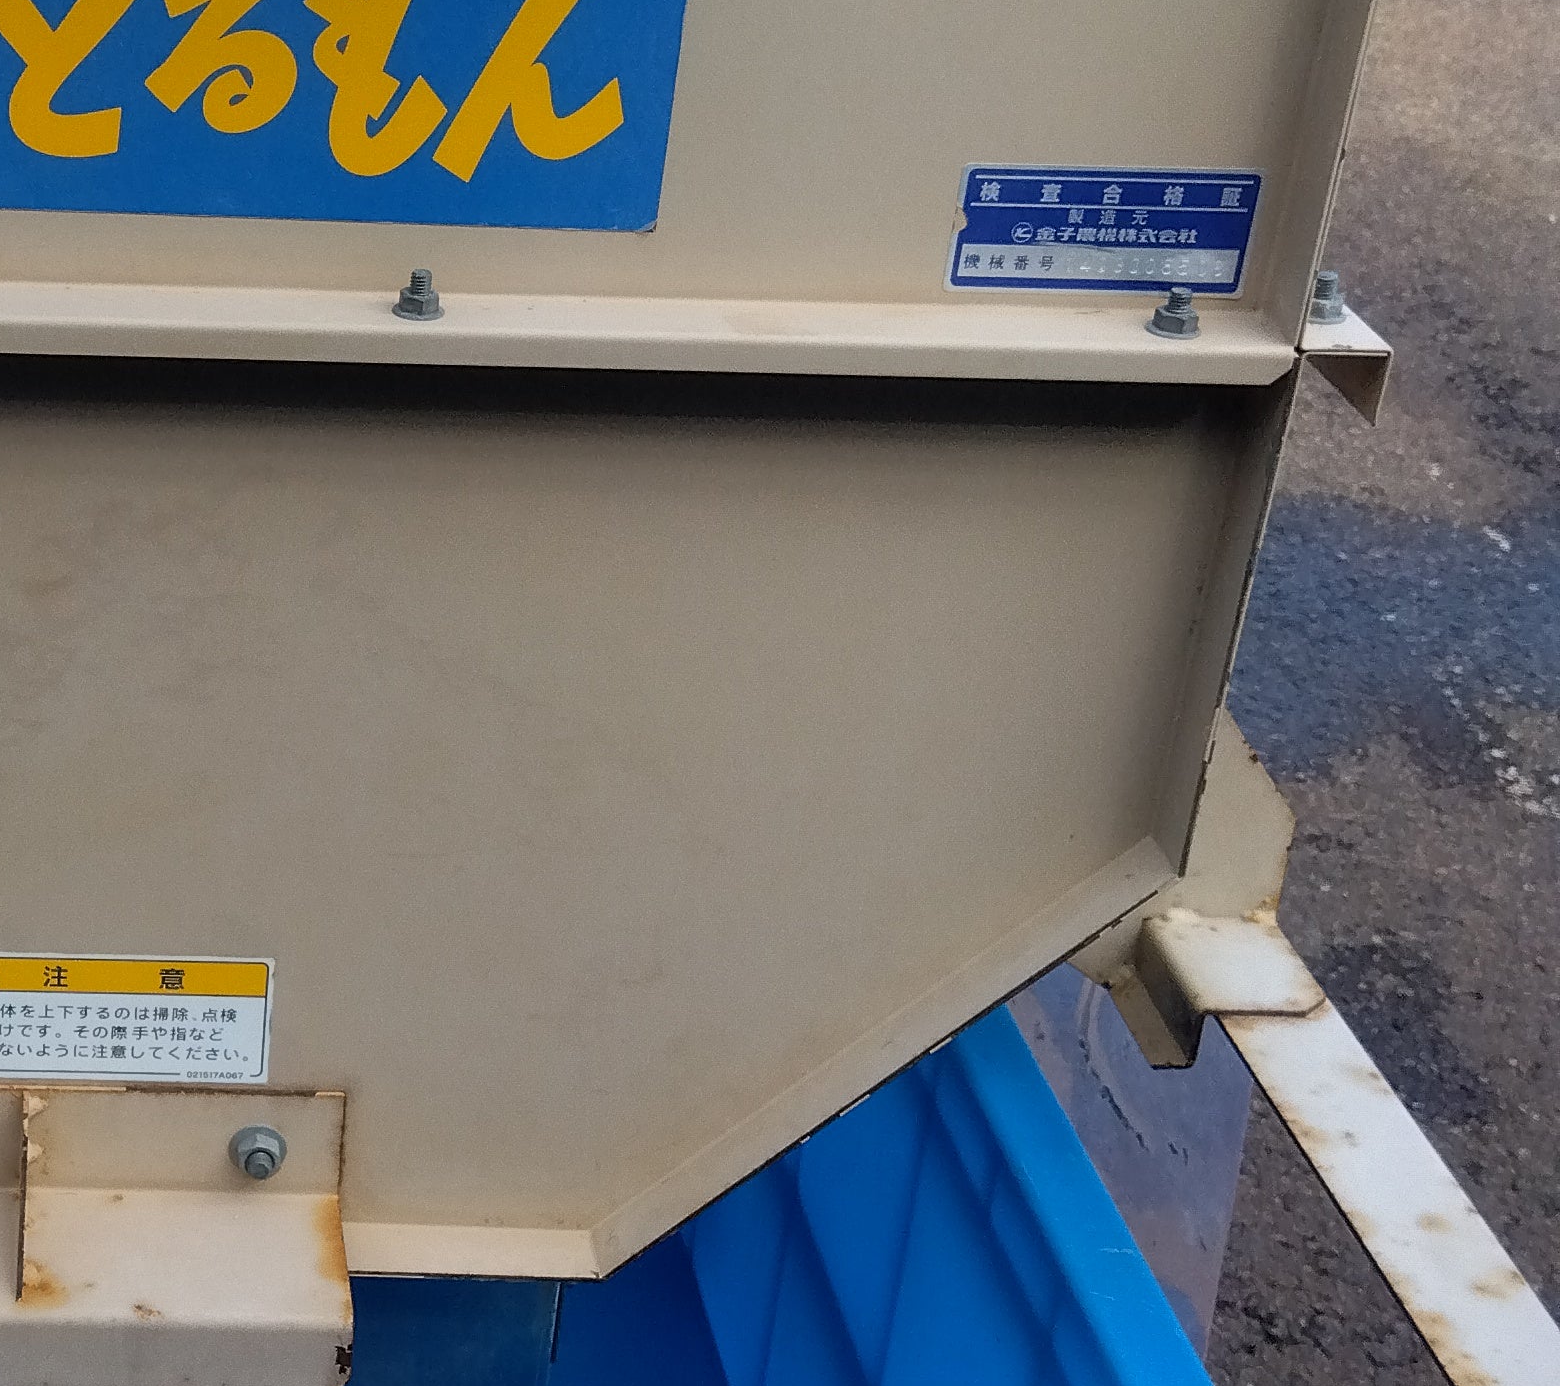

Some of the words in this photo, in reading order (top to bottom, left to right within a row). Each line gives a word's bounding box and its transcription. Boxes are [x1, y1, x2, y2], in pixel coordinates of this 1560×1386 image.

[963, 253, 1055, 272] 機械番号
[43, 965, 185, 990] 注意
